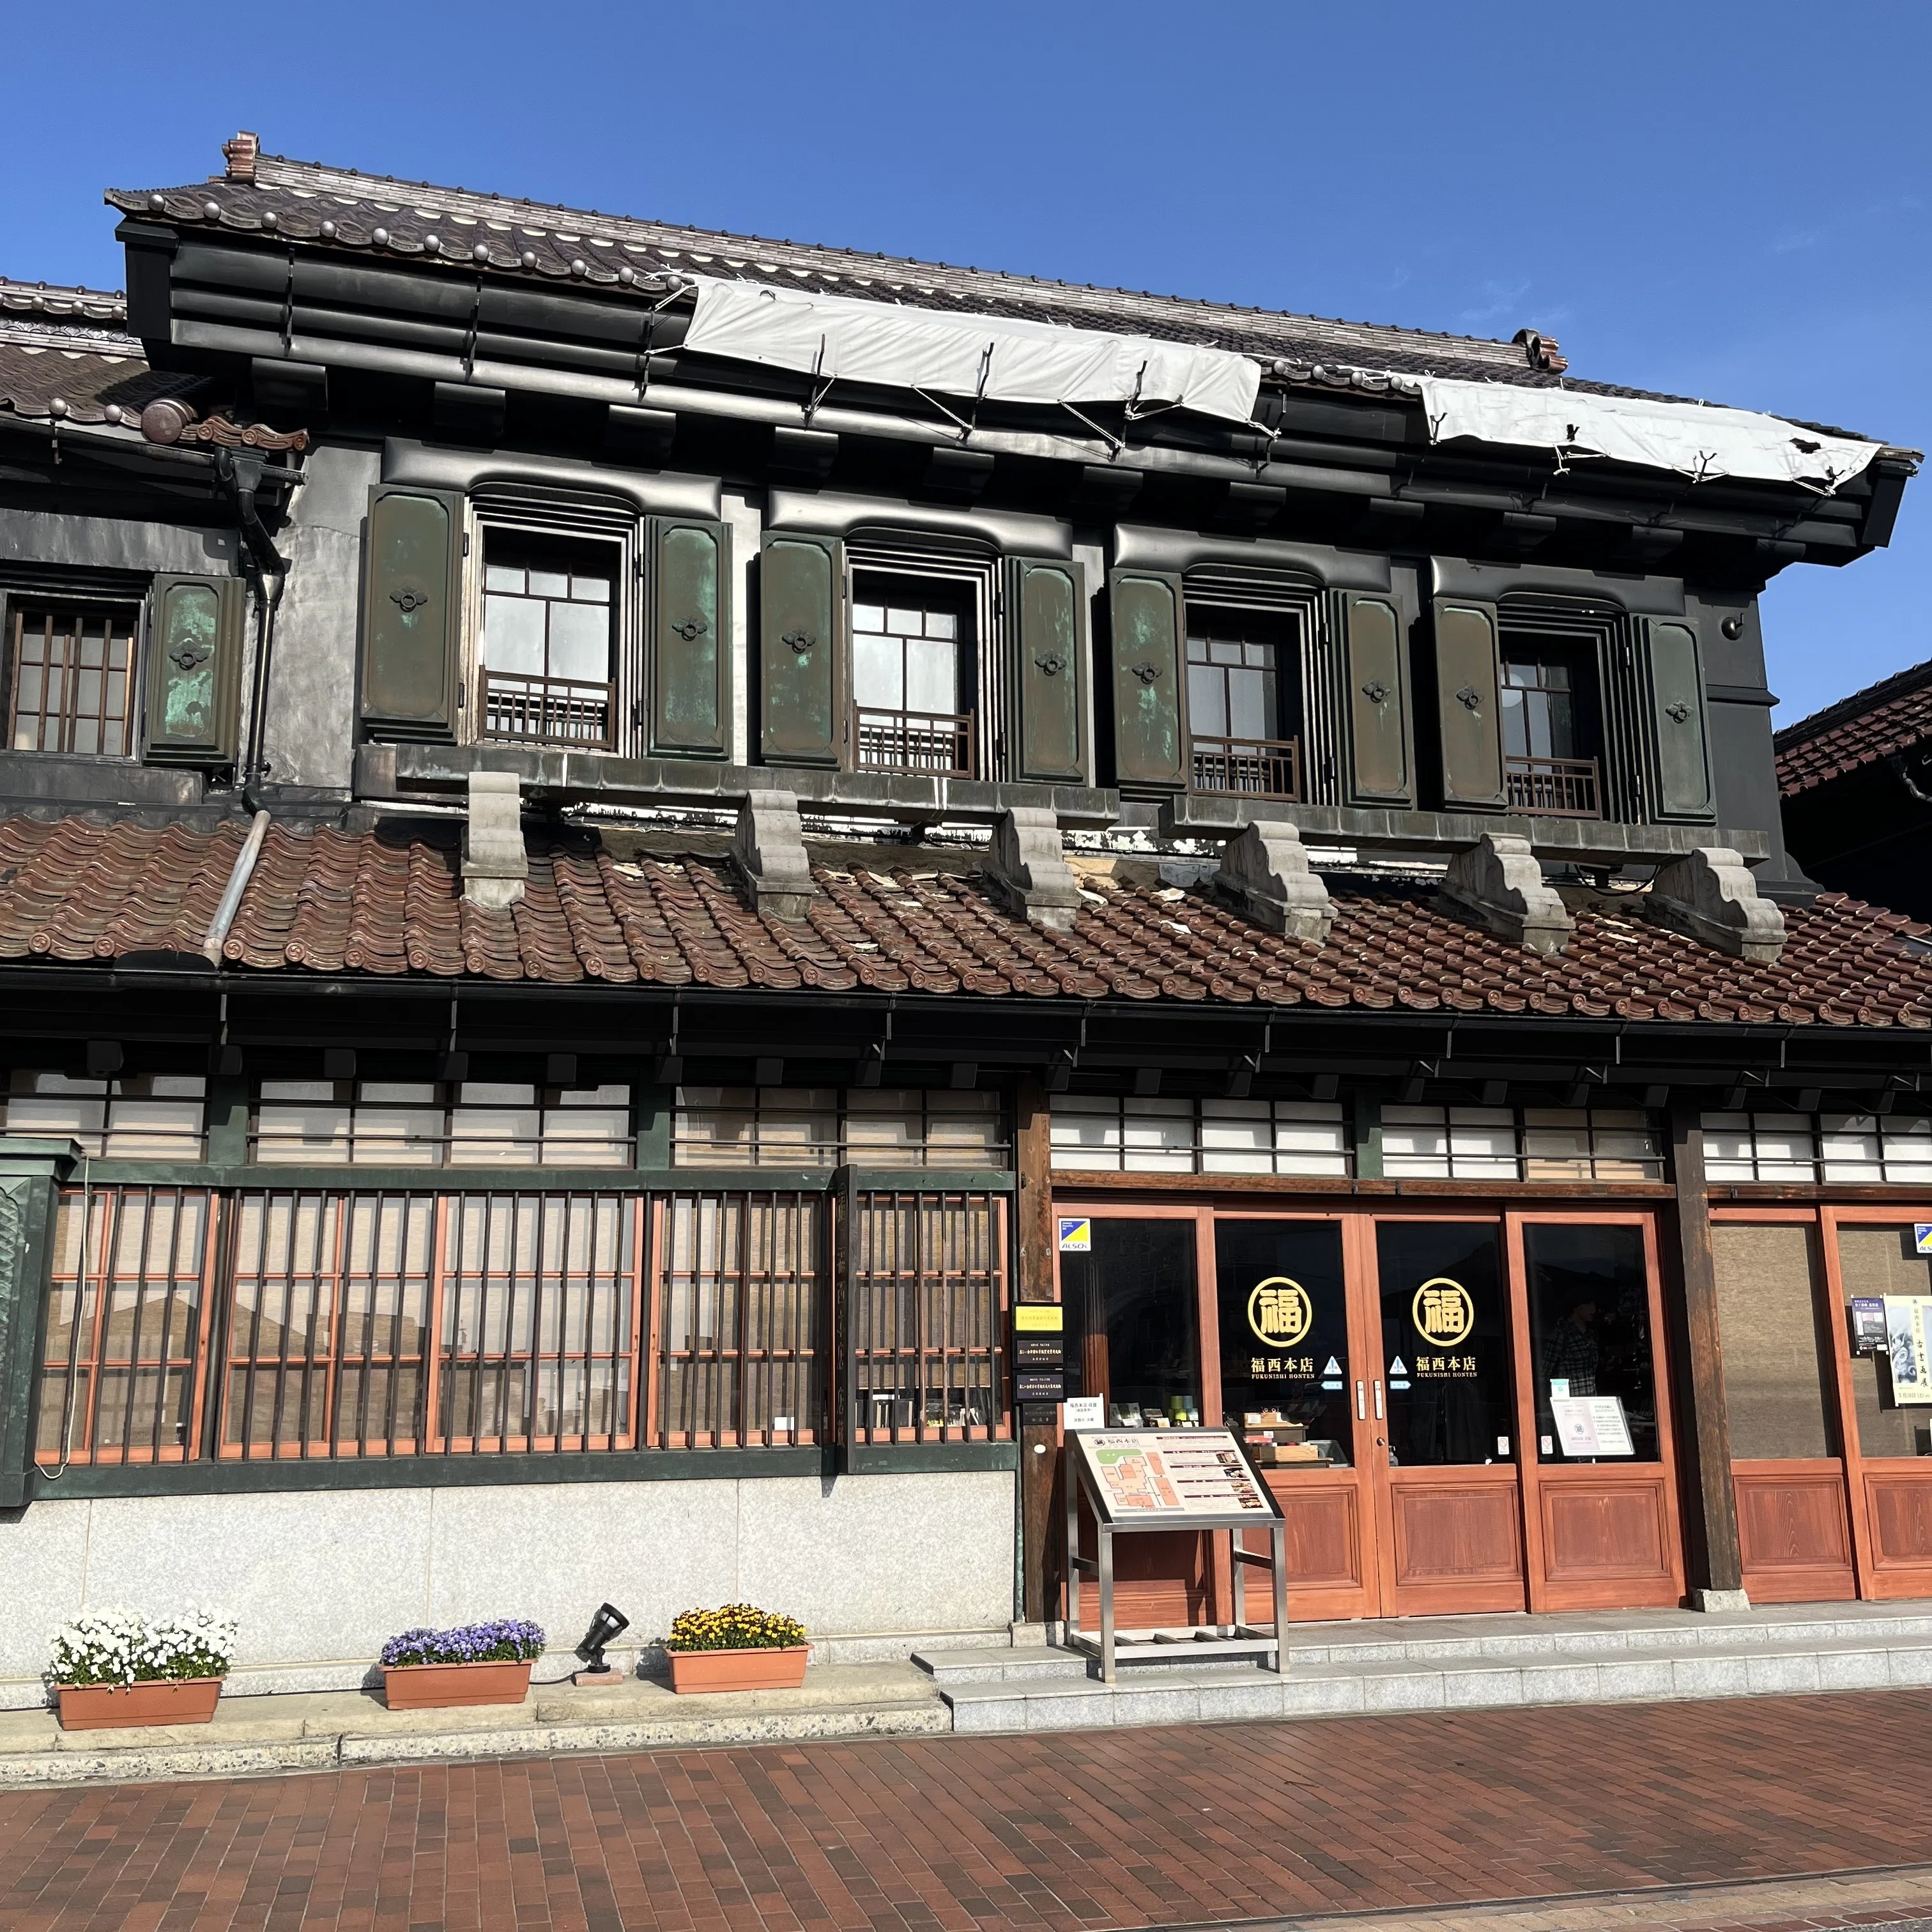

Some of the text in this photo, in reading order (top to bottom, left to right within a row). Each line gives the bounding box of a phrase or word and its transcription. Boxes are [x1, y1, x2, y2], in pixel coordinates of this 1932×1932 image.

[1259, 1288, 1302, 1334] 福
[1423, 1289, 1464, 1334] 福
[1251, 1357, 1314, 1372] 福西本店
[1416, 1356, 1476, 1371] 福西本店
